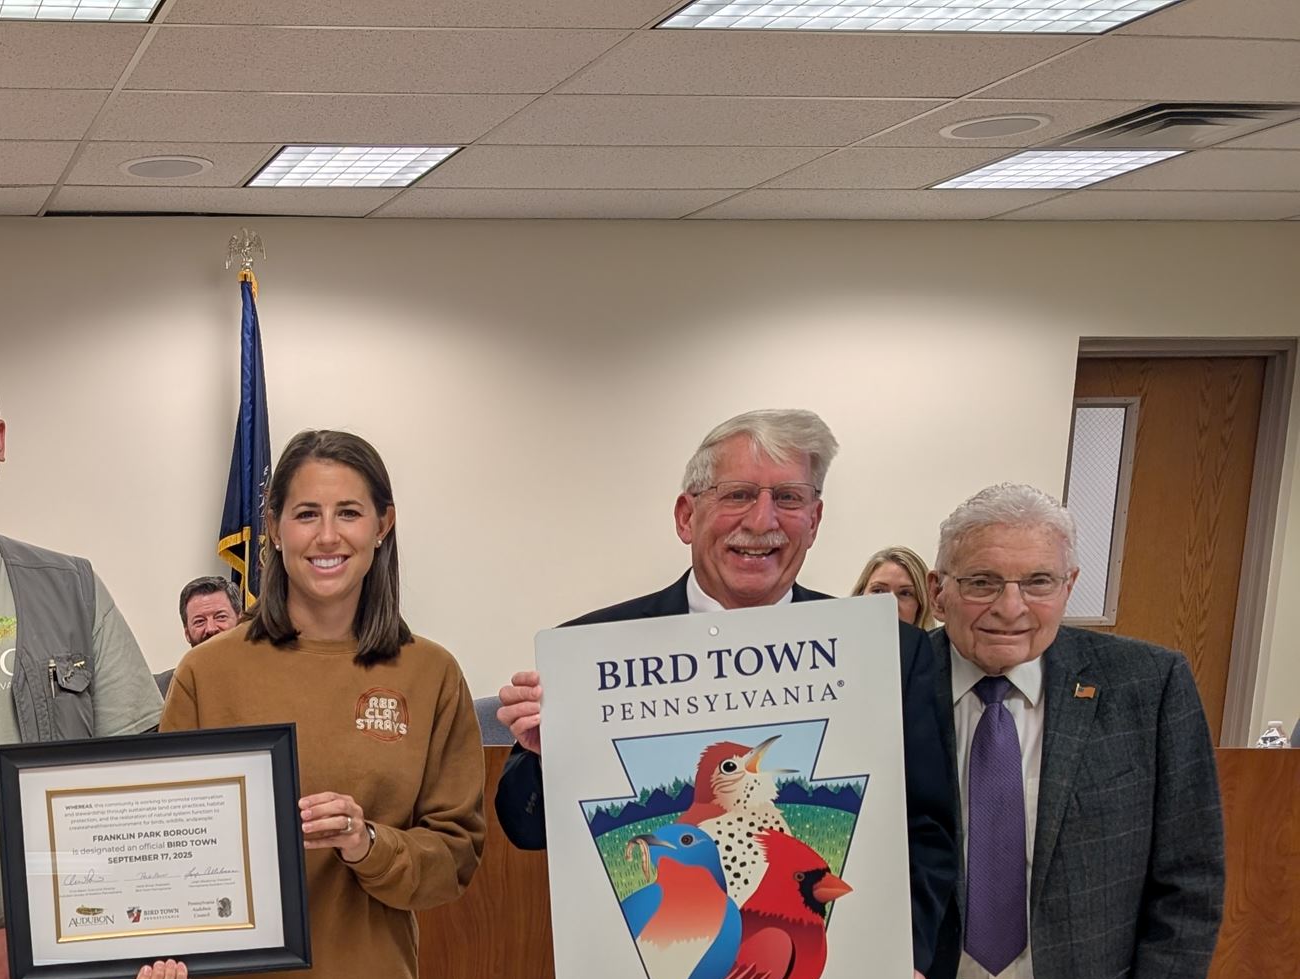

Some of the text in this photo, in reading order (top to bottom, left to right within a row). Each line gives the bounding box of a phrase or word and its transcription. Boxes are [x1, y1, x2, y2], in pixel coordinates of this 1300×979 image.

[596, 638, 838, 691] BIRD TOWN
[368, 696, 398, 710] RED
[364, 707, 400, 722] CLAY
[355, 718, 408, 735] STRAYS
[92, 827, 208, 843] FRANKLIN PARK BOROUGH
[72, 838, 218, 856] is designated an official BIRD TOWN
[107, 851, 194, 865] SEPTEMBER 17, 2025
[68, 914, 115, 928] AUDUBON
